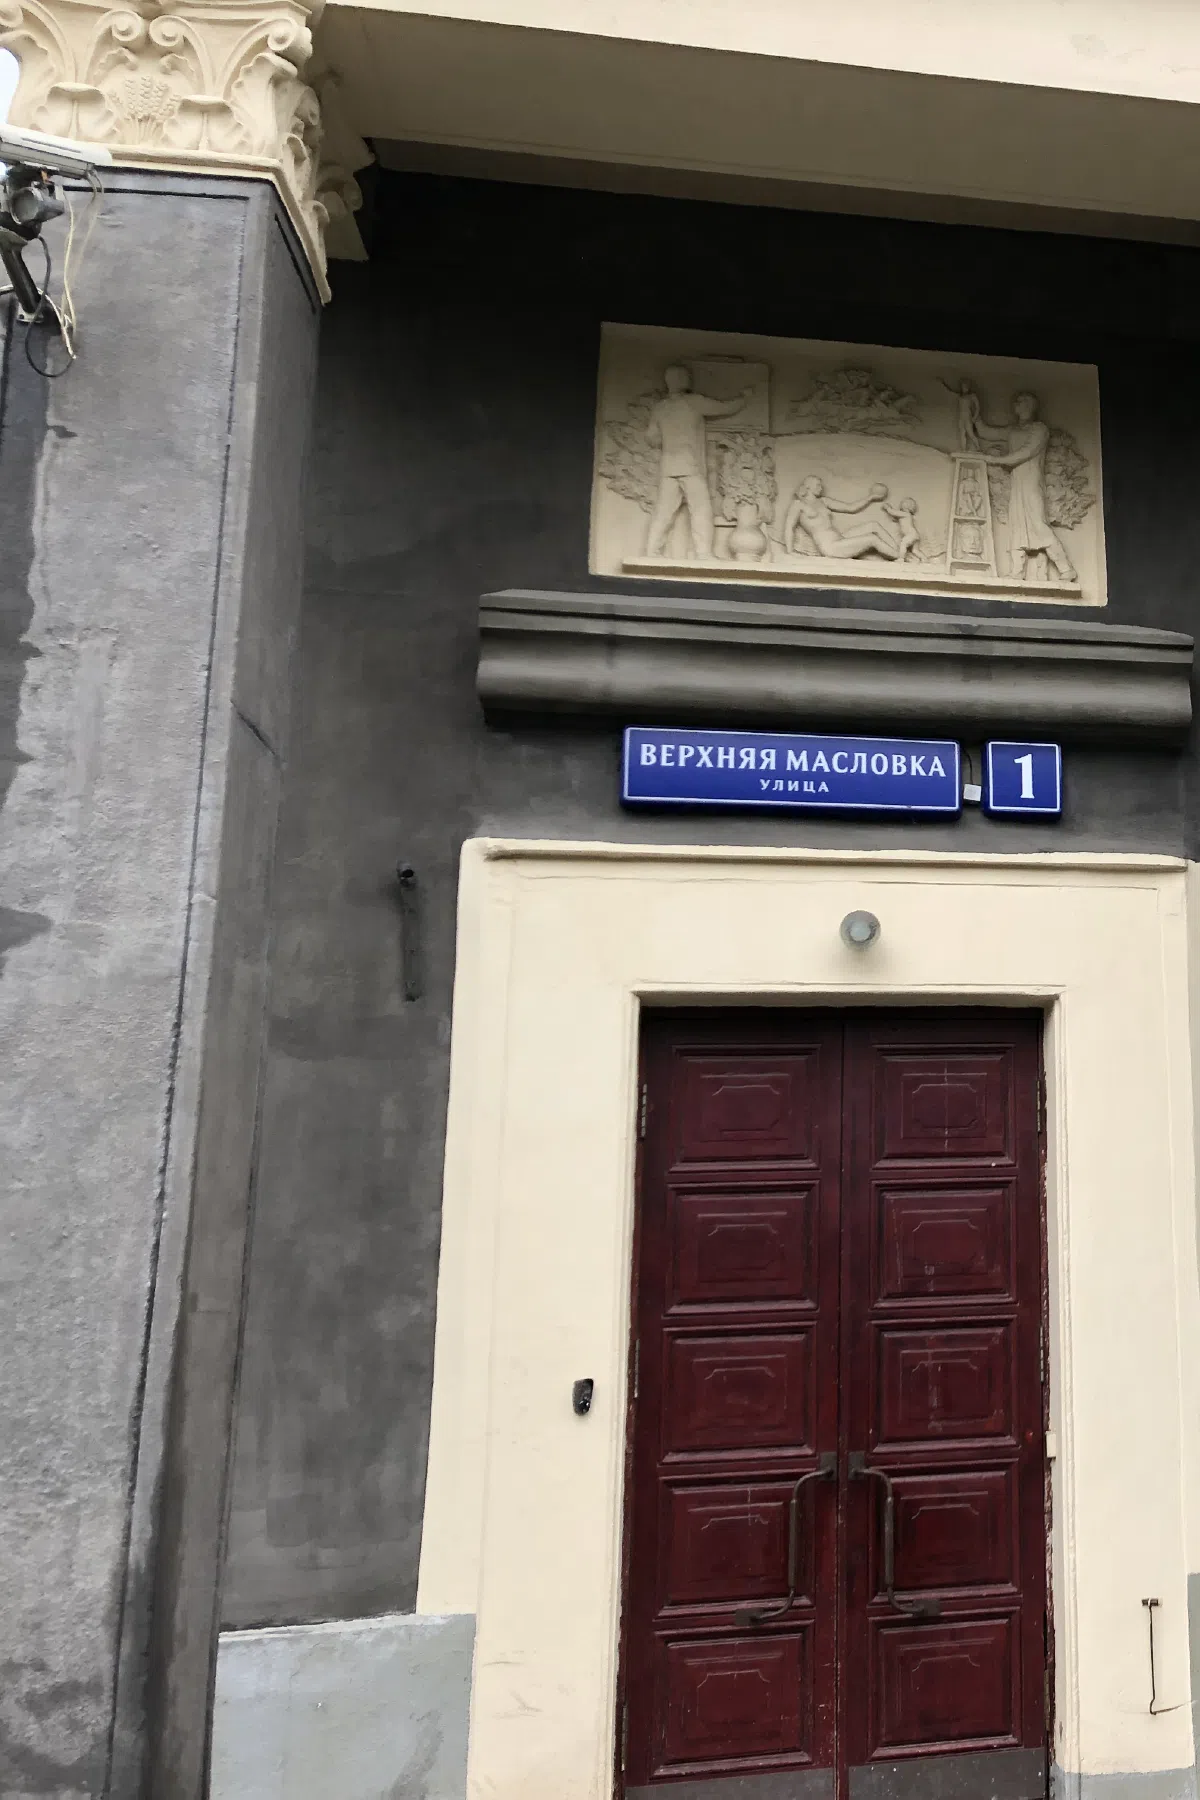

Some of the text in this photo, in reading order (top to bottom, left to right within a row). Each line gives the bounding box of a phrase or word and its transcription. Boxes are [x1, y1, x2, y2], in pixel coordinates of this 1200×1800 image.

[639, 743, 948, 777] ВЕРХНЯЯ МАСЛОВКА
[1013, 753, 1035, 799] 1
[760, 778, 830, 794] УЛИЦА
